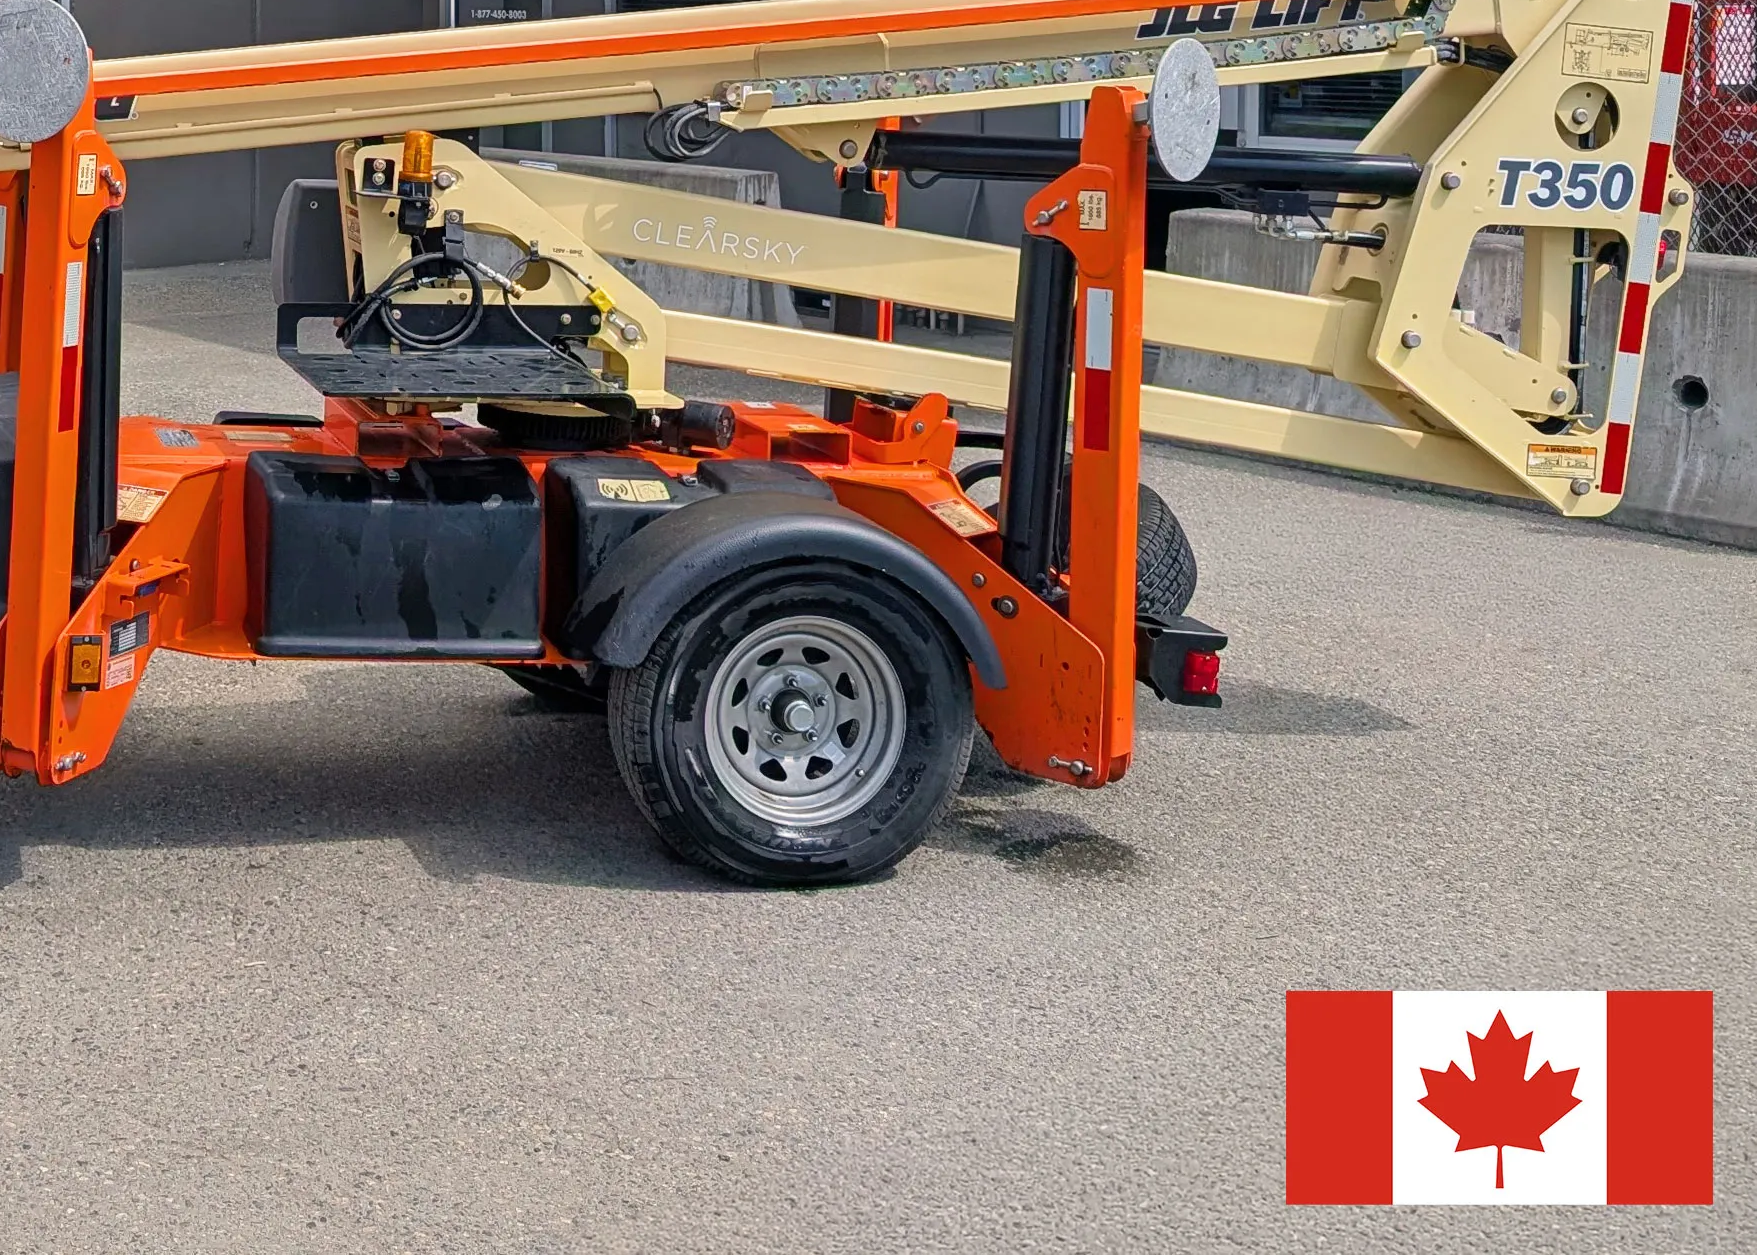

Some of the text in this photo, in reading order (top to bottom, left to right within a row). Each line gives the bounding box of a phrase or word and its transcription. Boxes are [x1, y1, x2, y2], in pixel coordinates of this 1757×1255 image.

[1135, 1, 1238, 40] JLG
[1495, 157, 1638, 214] T350
[632, 216, 805, 266] CLEARSKY
